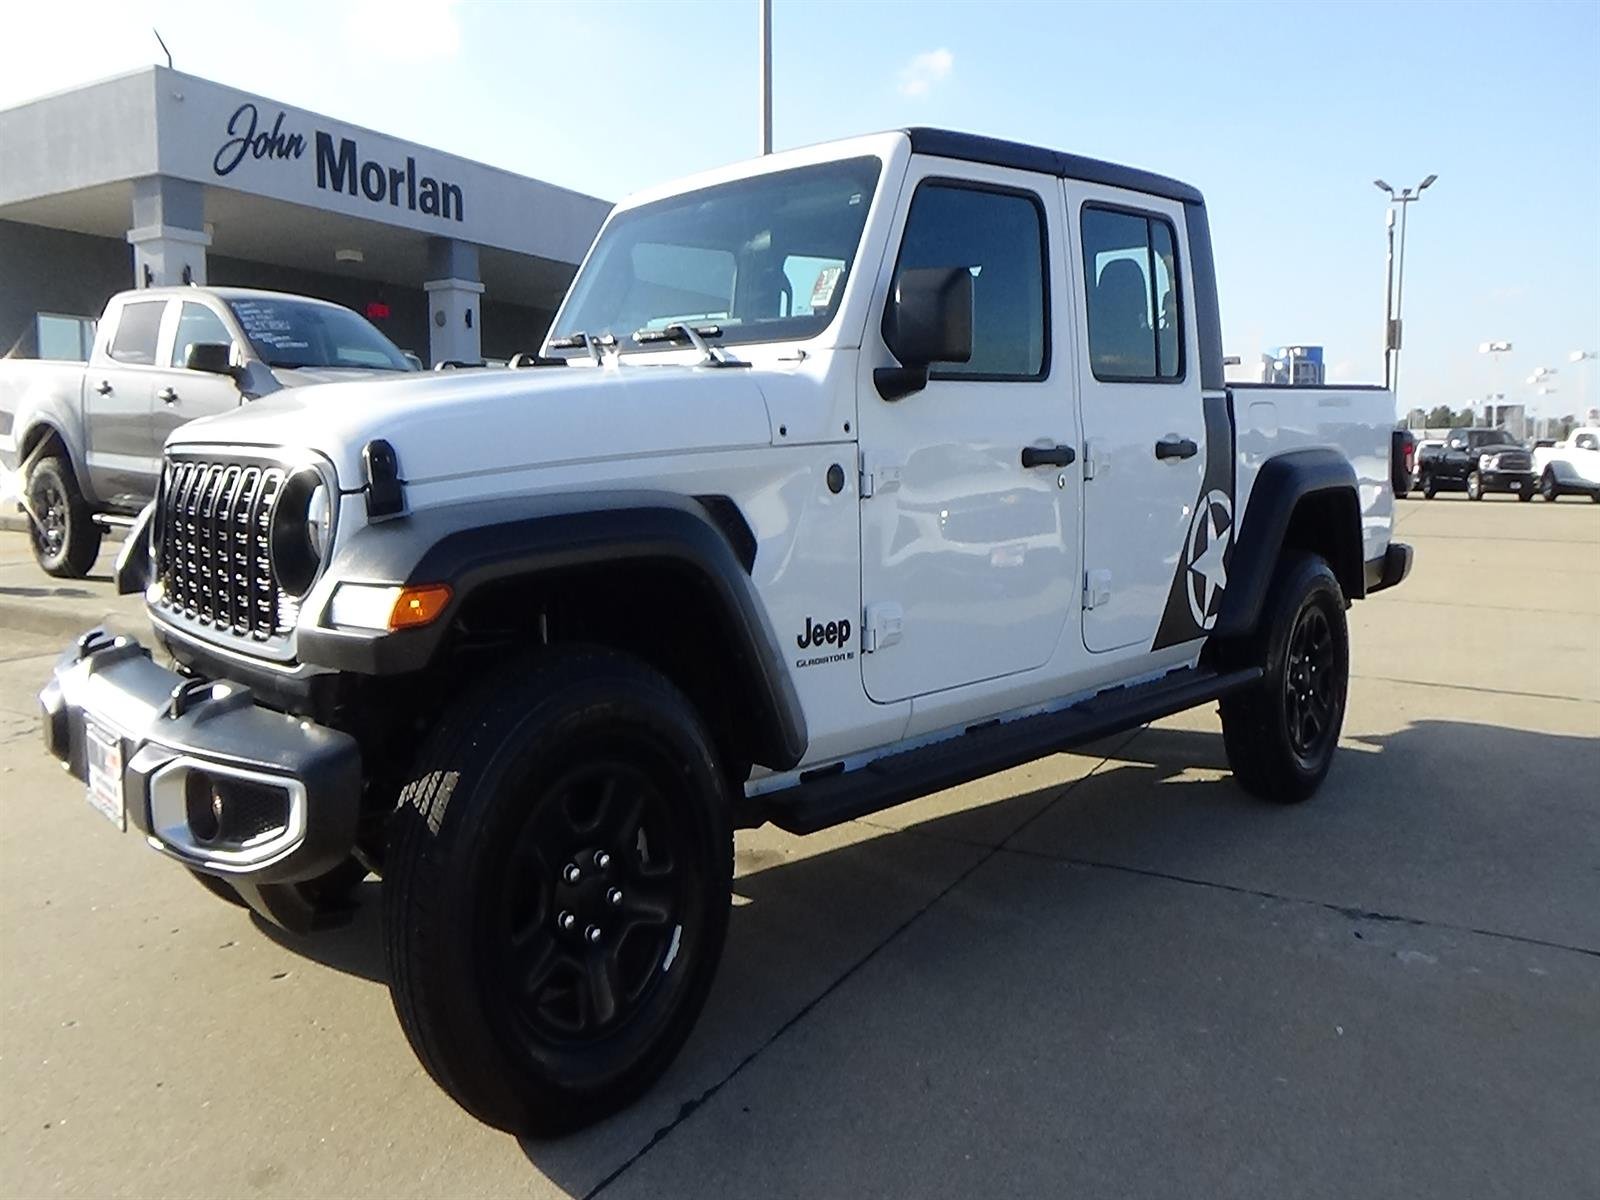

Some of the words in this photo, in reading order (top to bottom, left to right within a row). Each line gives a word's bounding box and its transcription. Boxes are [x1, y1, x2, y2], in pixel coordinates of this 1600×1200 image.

[213, 103, 307, 176] John
[315, 130, 463, 222] Morlan
[797, 616, 851, 649] Jeep
[796, 653, 846, 668] GLADIATOR
